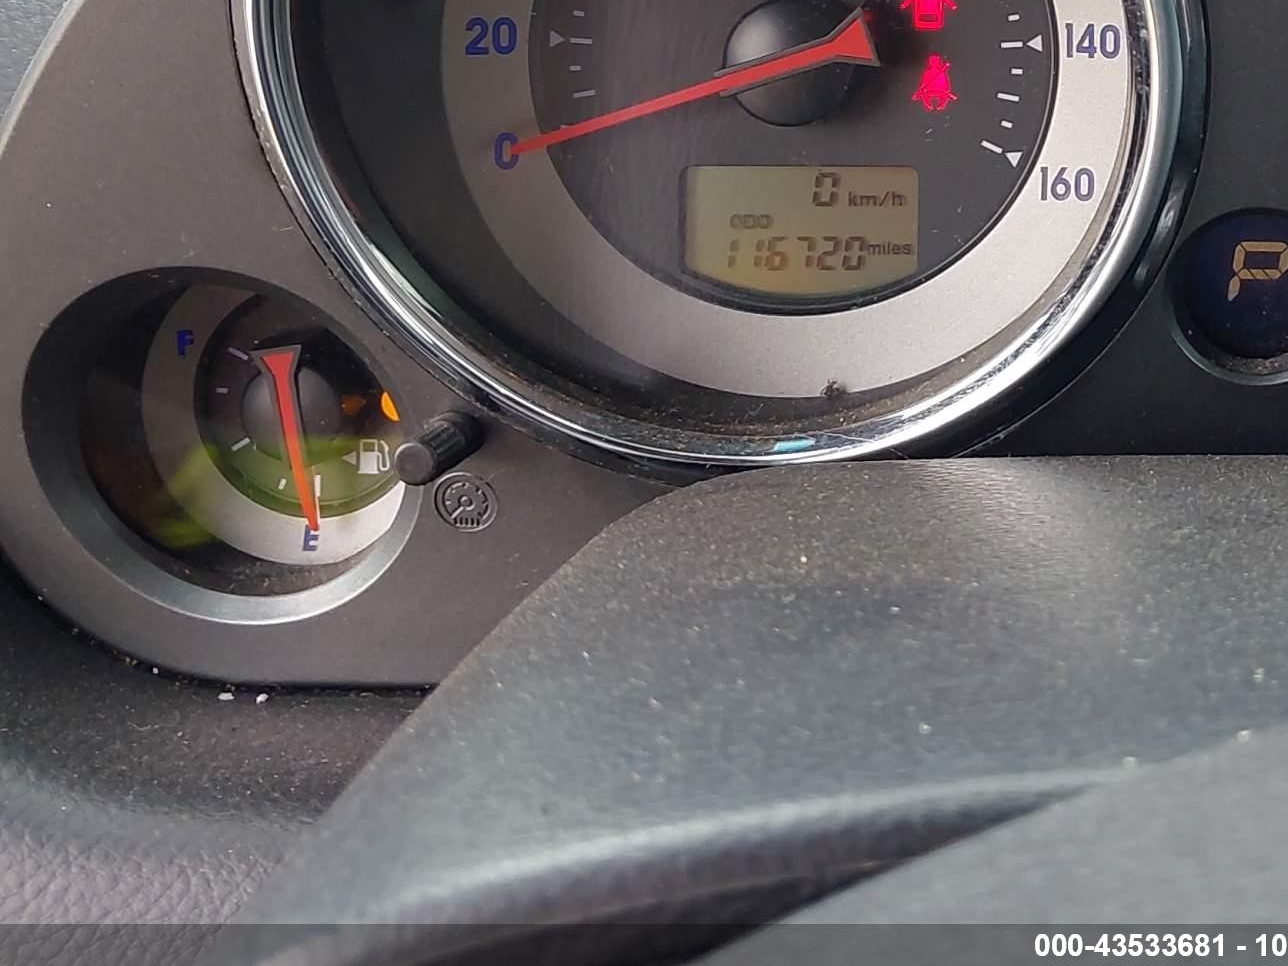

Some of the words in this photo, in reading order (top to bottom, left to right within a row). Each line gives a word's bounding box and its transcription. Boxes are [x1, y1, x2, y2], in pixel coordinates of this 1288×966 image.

[464, 17, 517, 55] 20
[1065, 23, 1121, 60] 140
[494, 132, 520, 170] 0
[812, 172, 842, 207] 0
[847, 191, 906, 207] km/h
[1039, 166, 1095, 202] 160
[730, 214, 774, 229] ODO
[727, 236, 867, 271] 116720
[868, 241, 912, 256] miles
[176, 329, 194, 356] F
[302, 525, 320, 552] E
